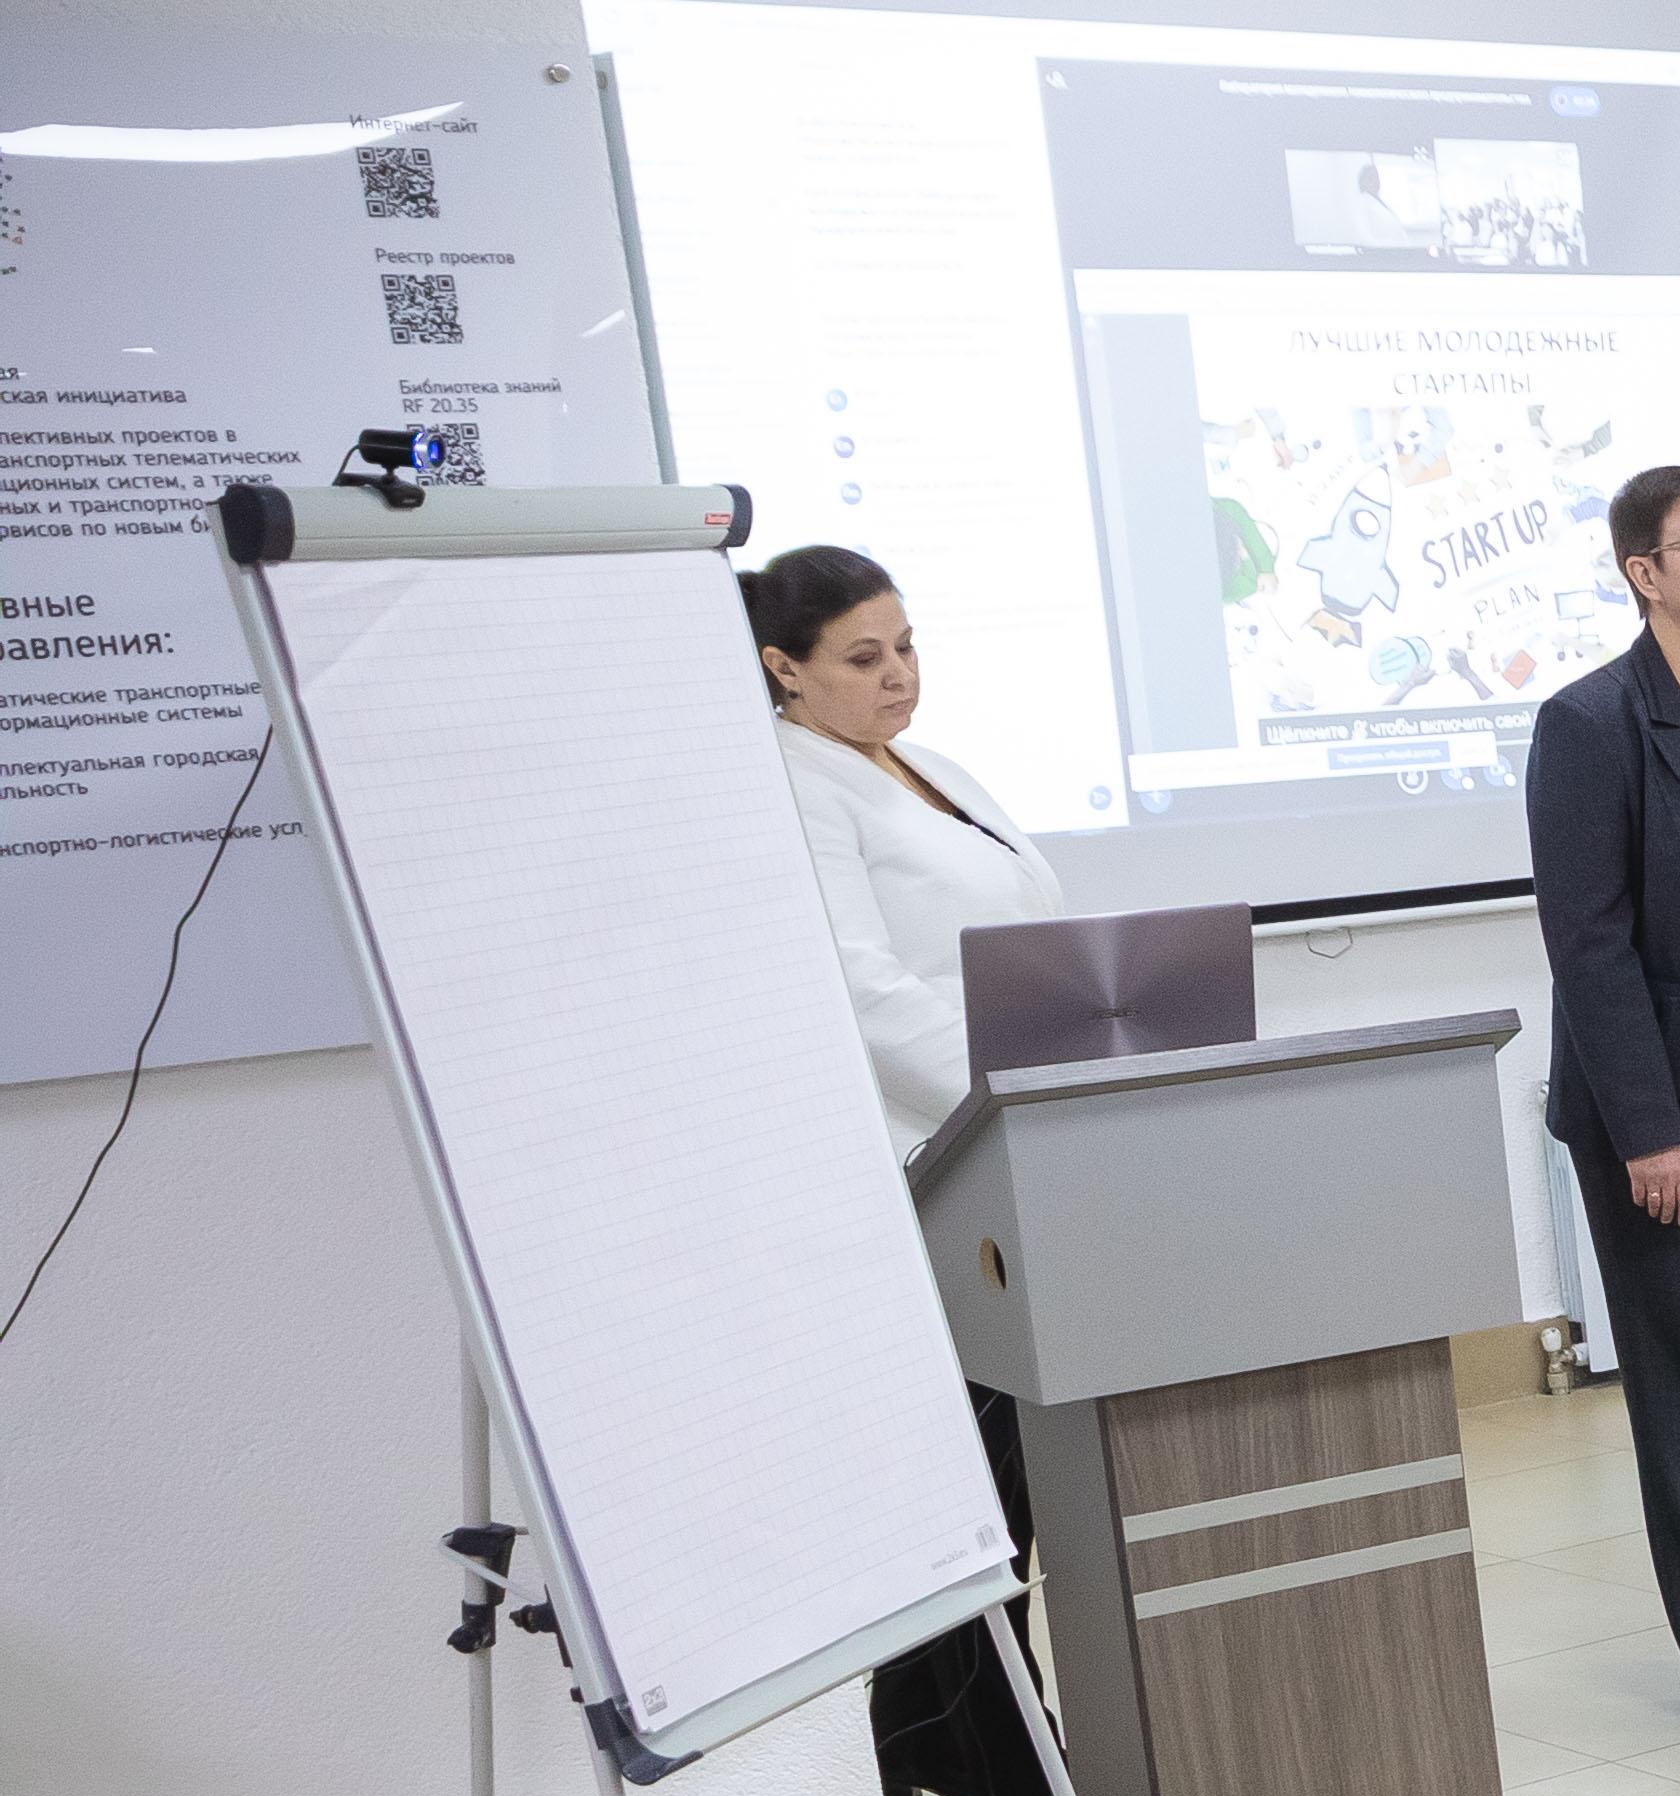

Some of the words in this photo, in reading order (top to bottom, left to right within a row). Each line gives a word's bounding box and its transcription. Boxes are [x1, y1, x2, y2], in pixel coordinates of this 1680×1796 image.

[375, 248, 433, 264] Реестр
[440, 252, 515, 266] проектов
[1418, 330, 1620, 356] МОЛОДЕЖНЫЕ
[399, 378, 499, 394] Библиотека
[504, 378, 561, 393] знаний
[1393, 373, 1532, 395] СТАРТАПЫ
[57, 386, 187, 405] инициатива
[403, 399, 424, 413] RF
[431, 398, 479, 413] 20.35
[121, 428, 218, 446] проектов
[226, 429, 237, 442] в
[135, 449, 302, 468] телематических
[107, 475, 185, 490] систем,
[193, 476, 205, 489] а
[49, 500, 61, 514] и
[81, 521, 106, 536] по
[115, 517, 184, 534] новым
[114, 680, 262, 704] транспортные
[157, 705, 243, 723] системы
[153, 748, 259, 769] городская
